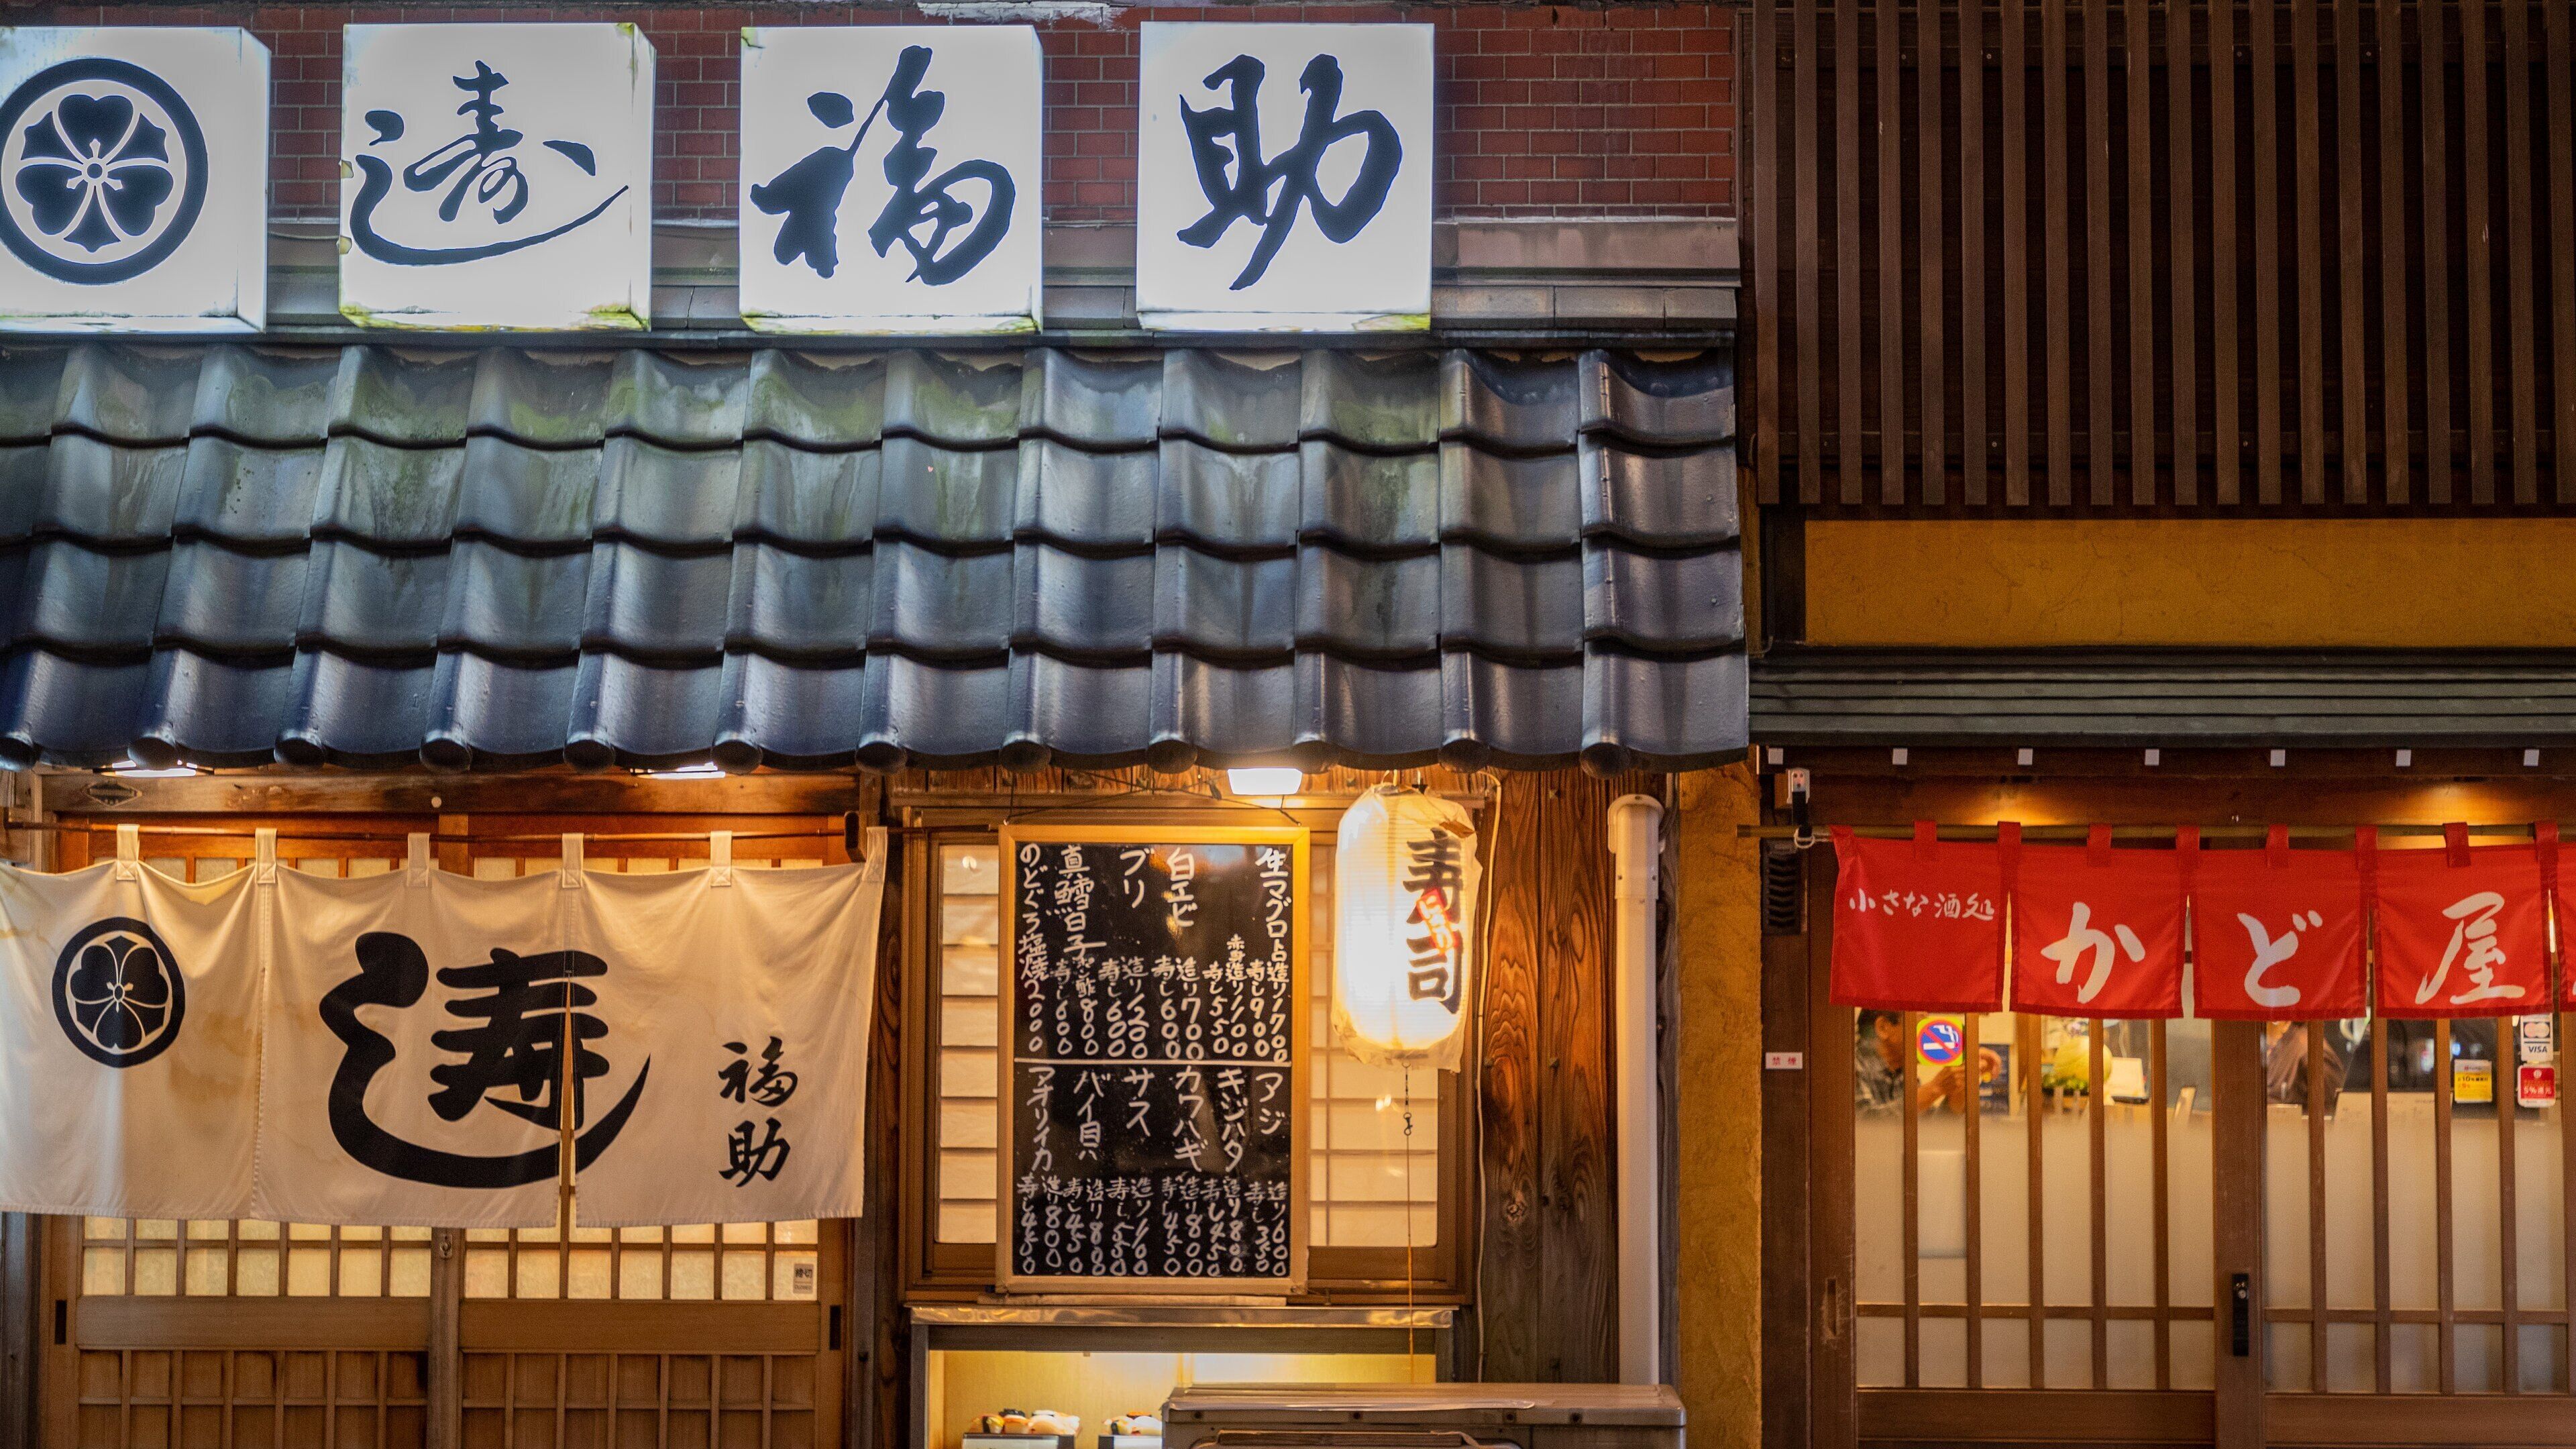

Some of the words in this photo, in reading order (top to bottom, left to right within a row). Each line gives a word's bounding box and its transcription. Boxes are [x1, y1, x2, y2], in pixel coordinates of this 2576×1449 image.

[1120, 848, 1155, 909] ブリ
[1166, 847, 1198, 927] 白エビ
[1403, 827, 1464, 1014] 寿司
[1849, 888, 1996, 922] 小さな酒処
[2041, 891, 2526, 1008] かど屋
[2528, 1045, 2548, 1053] VISA
[718, 1036, 799, 1188] 福助
[1026, 1066, 1056, 1171] アオリイカ
[1073, 1071, 1112, 1161] バイ貝
[1121, 1067, 1155, 1137] サス
[1173, 1065, 1208, 1173] カワハギ
[1217, 1069, 1248, 1173] キジハタ
[1255, 1073, 1286, 1135] アジ
